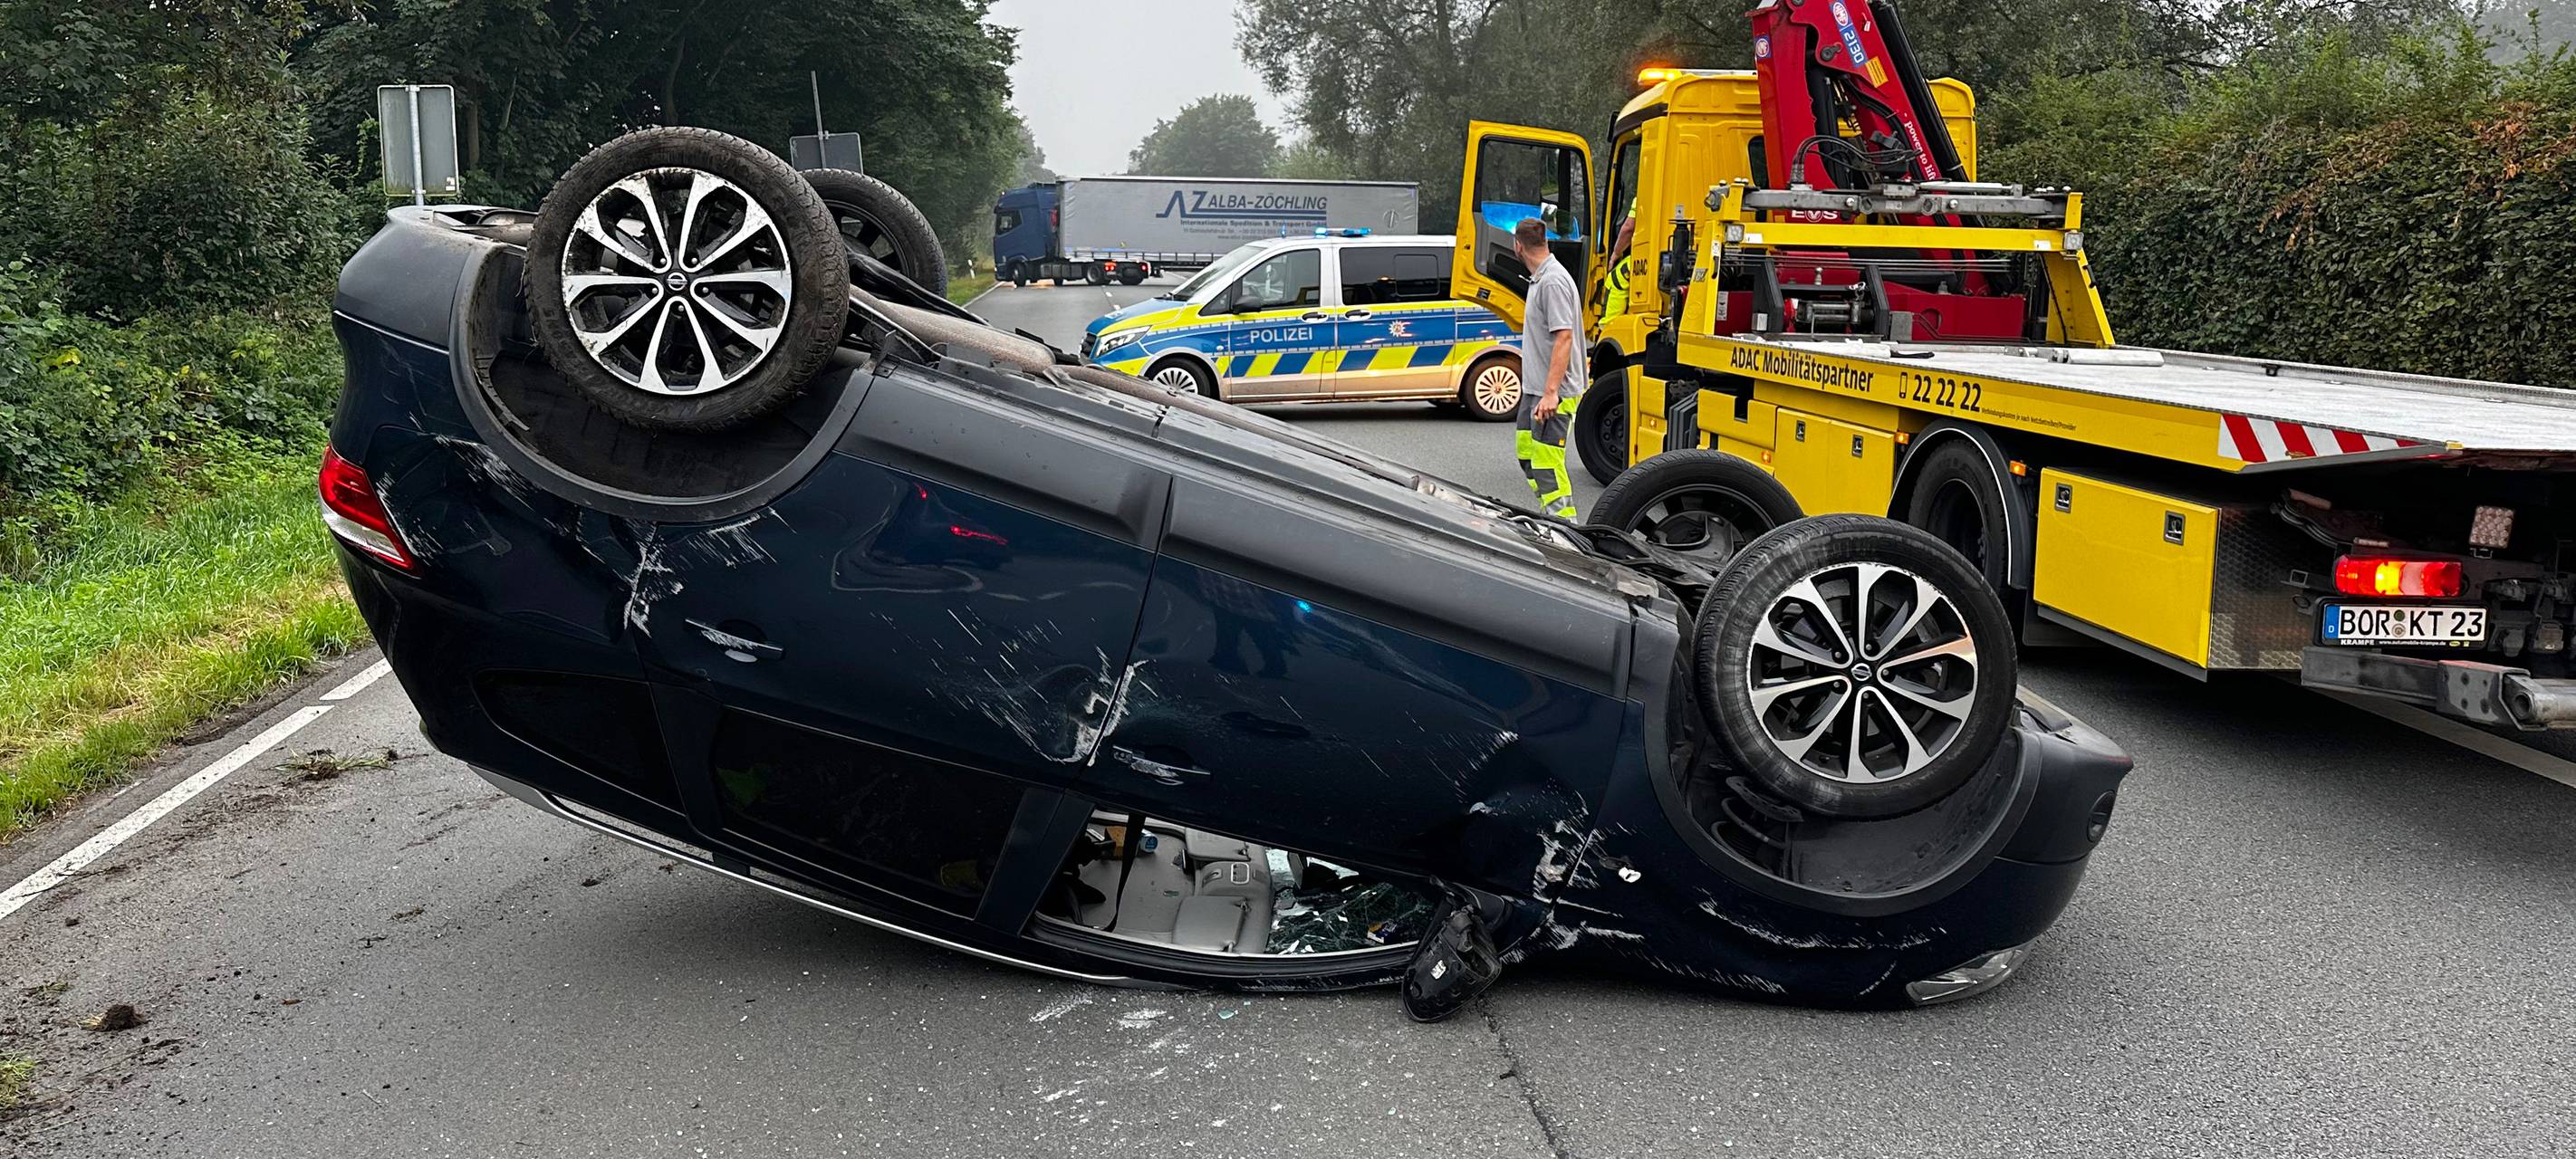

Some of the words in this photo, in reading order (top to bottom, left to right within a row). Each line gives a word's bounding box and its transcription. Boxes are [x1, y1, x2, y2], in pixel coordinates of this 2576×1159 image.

[1843, 30, 1864, 63] 2130
[1904, 120, 1923, 152] power
[1920, 153, 1927, 165] to
[1208, 193, 1328, 210] ALBA-ZÖCHLING
[1632, 258, 1648, 277] ADAC
[1250, 327, 1312, 343] POLIZEI
[1730, 347, 1760, 371] ADAC
[1763, 350, 1874, 392] Mobilitätspartner
[1913, 374, 1932, 403] 22
[1936, 378, 1956, 407] 22
[1960, 381, 1982, 412] 22
[2328, 625, 2334, 633] D
[2340, 609, 2390, 636] BOR
[2410, 610, 2443, 637] KT
[2450, 611, 2483, 637] 23
